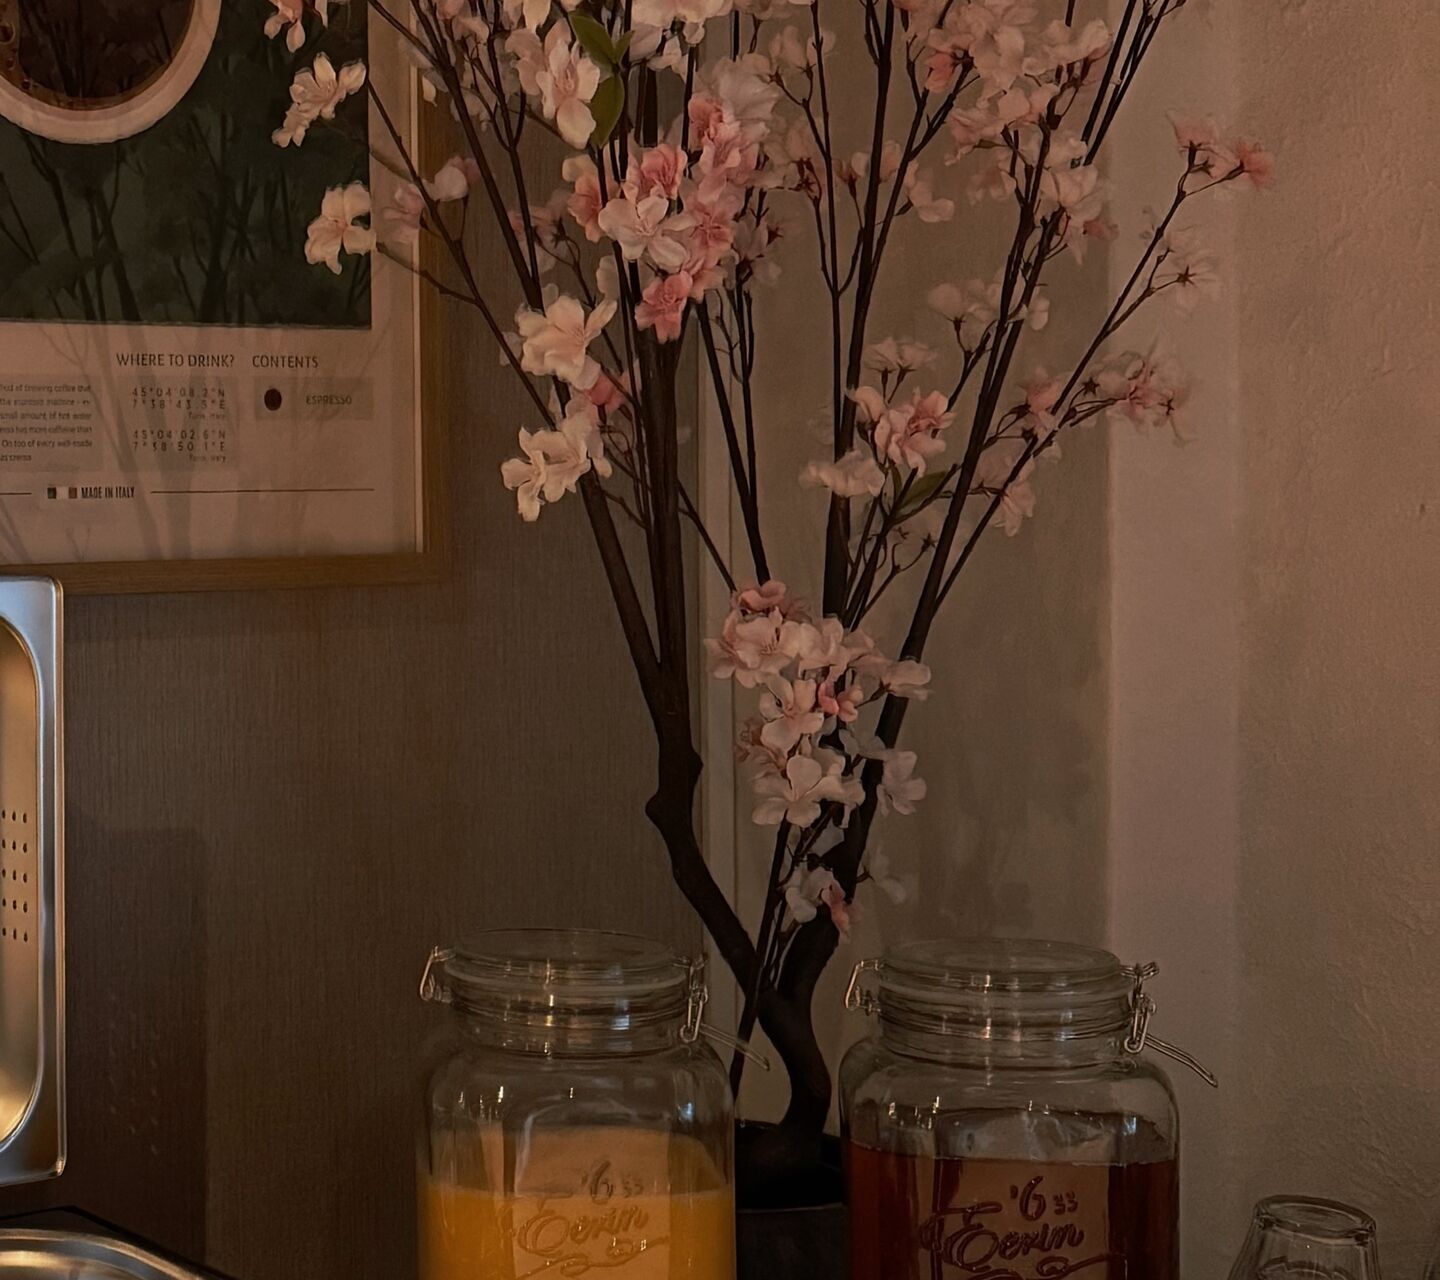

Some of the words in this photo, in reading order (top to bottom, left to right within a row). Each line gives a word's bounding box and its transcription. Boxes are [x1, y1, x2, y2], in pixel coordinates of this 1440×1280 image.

[116, 354, 165, 367] WHERE
[169, 354, 184, 367] TO
[188, 355, 235, 368] DRINK?
[252, 355, 319, 369] CONTENTS
[306, 396, 351, 405] ESPRESSO
[81, 487, 103, 498] MADE
[105, 487, 113, 498] IN
